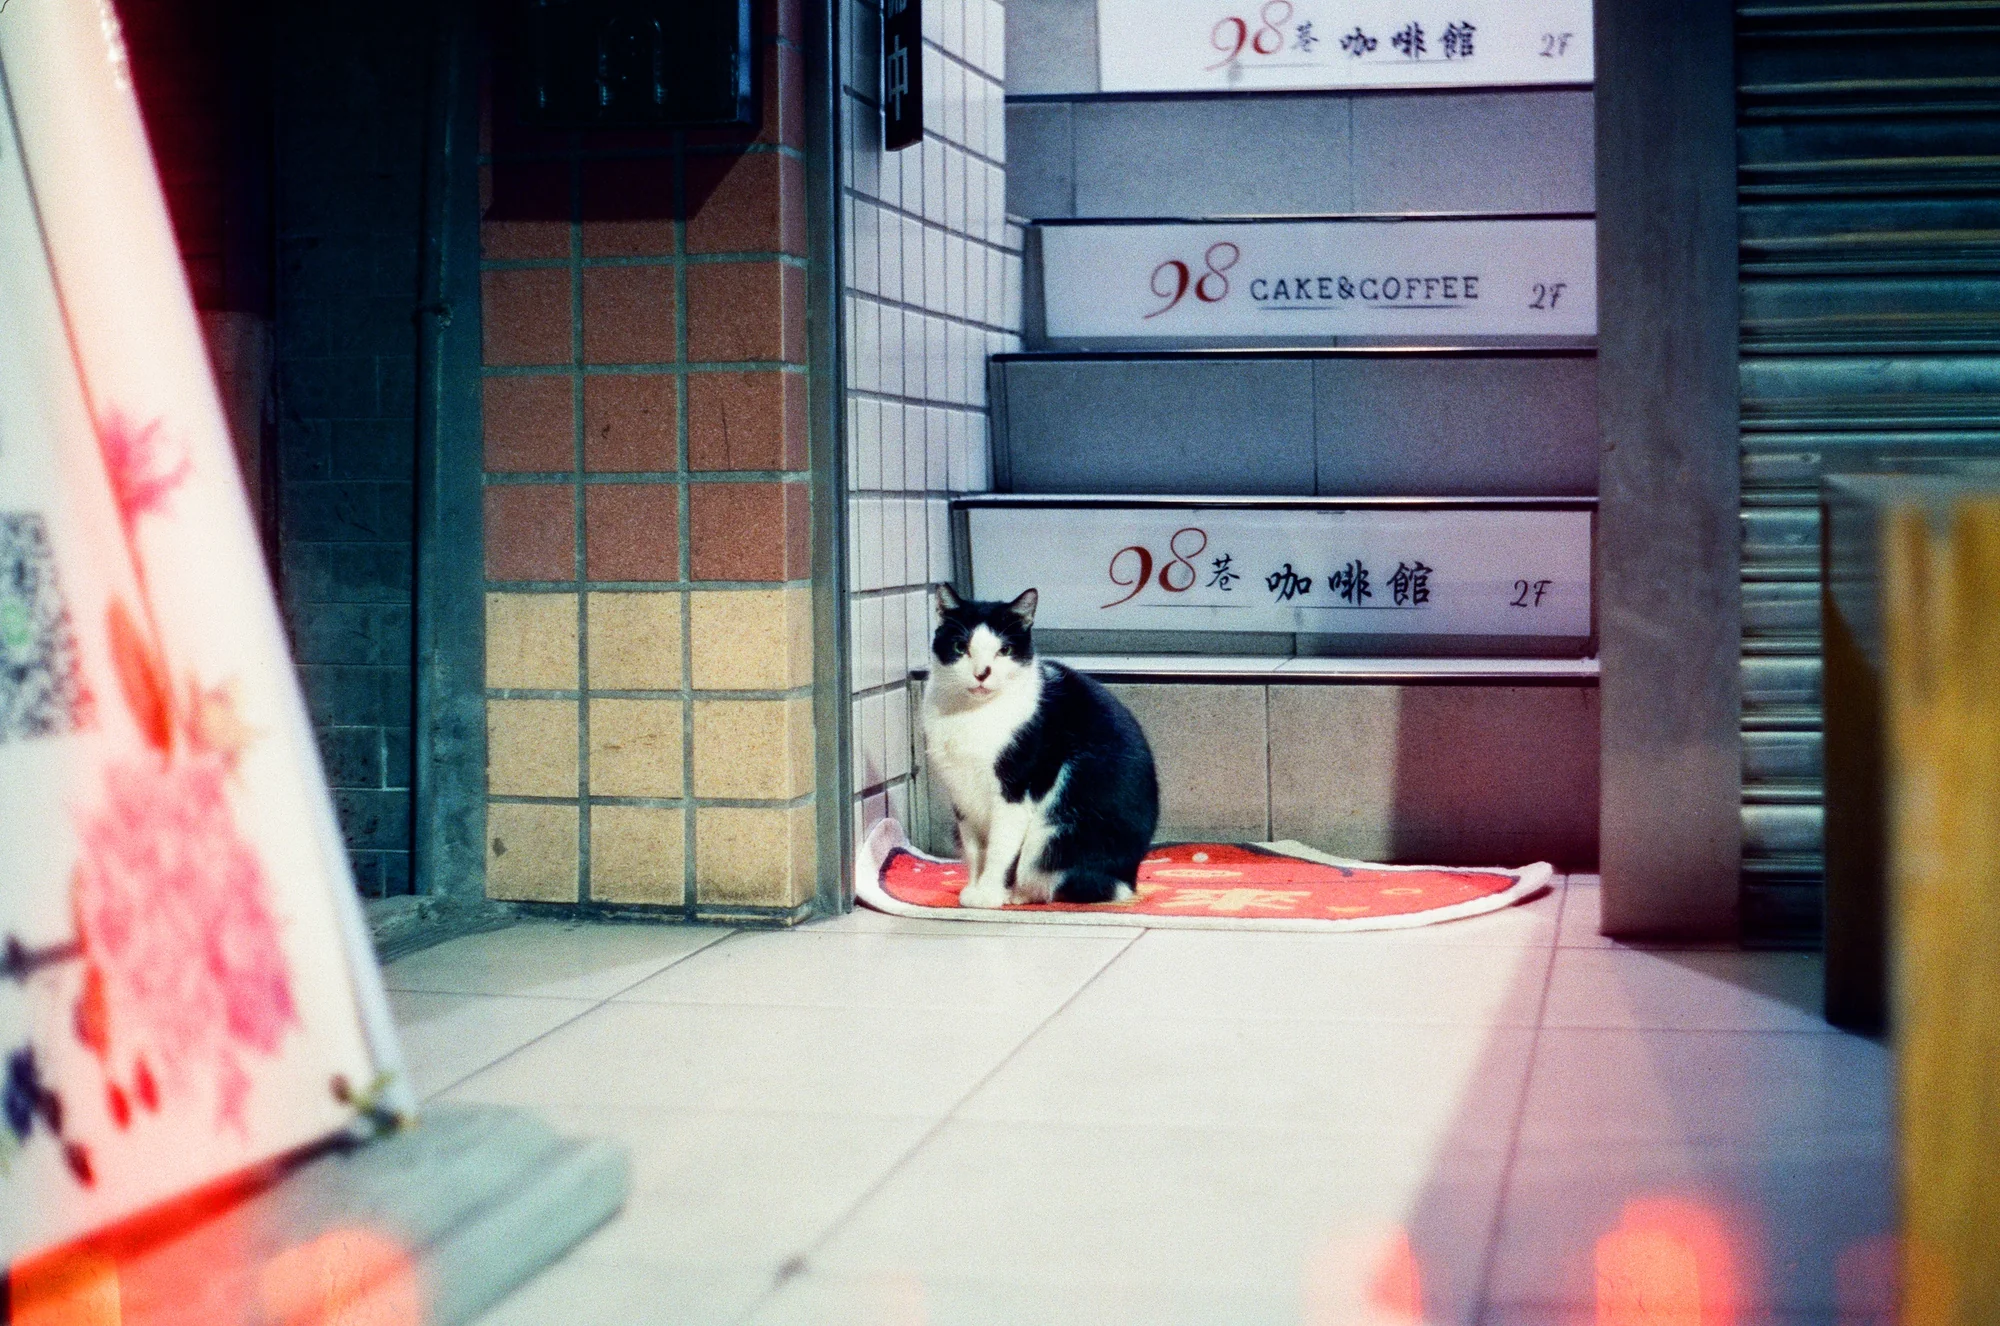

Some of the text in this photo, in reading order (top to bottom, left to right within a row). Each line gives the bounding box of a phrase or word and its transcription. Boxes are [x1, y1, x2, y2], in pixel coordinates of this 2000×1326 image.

[1339, 20, 1476, 60] 咖啡館
[1539, 32, 1573, 58] 2F
[1143, 241, 1568, 319] 98 CAKE&COFFEE 2F
[1265, 559, 1433, 606] 咖啡館
[1510, 579, 1553, 608] 2F
